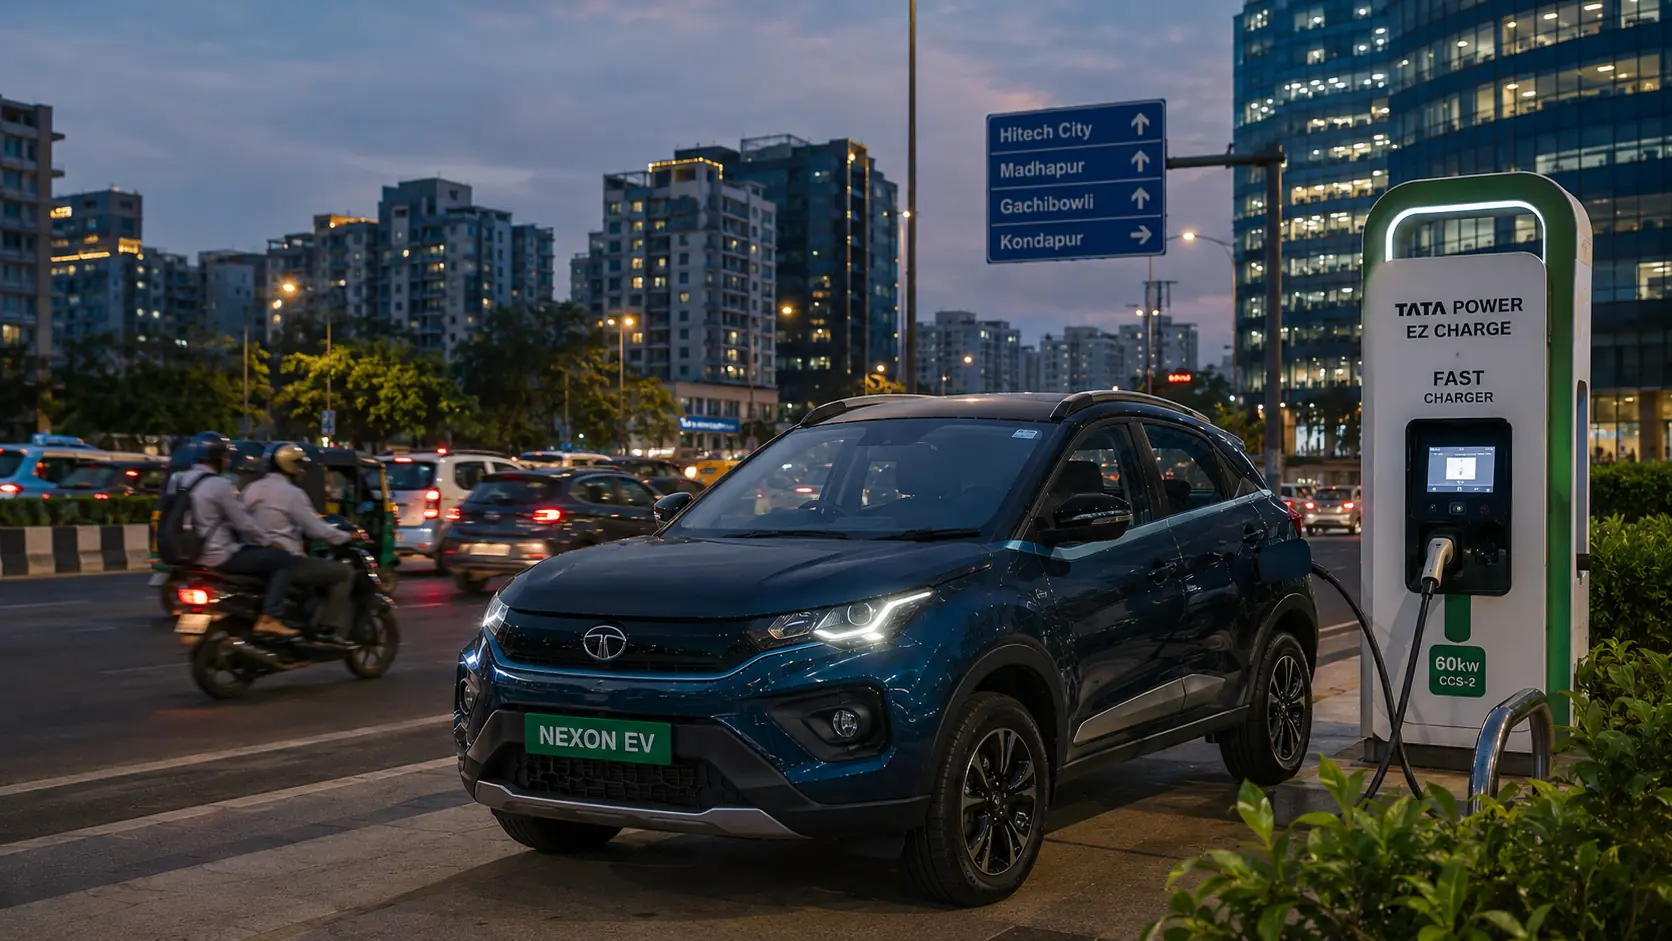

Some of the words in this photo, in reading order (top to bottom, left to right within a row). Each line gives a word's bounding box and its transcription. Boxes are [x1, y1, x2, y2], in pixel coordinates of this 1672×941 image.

[1000, 125, 1052, 142] Hitech
[1059, 122, 1092, 140] City
[1000, 160, 1084, 178] Madhapur
[1000, 194, 1094, 214] Gachibowli
[1001, 233, 1084, 250] Kondapur
[1395, 302, 1446, 316] TATA
[1453, 298, 1523, 314] POWER
[1407, 325, 1428, 338] EZ
[1434, 322, 1511, 338] CHARGE
[1434, 370, 1484, 386] FAST
[1424, 392, 1494, 404] CHARGER
[1440, 676, 1476, 688] CCS-2
[540, 726, 616, 750] NEXON
[625, 732, 654, 752] EV
